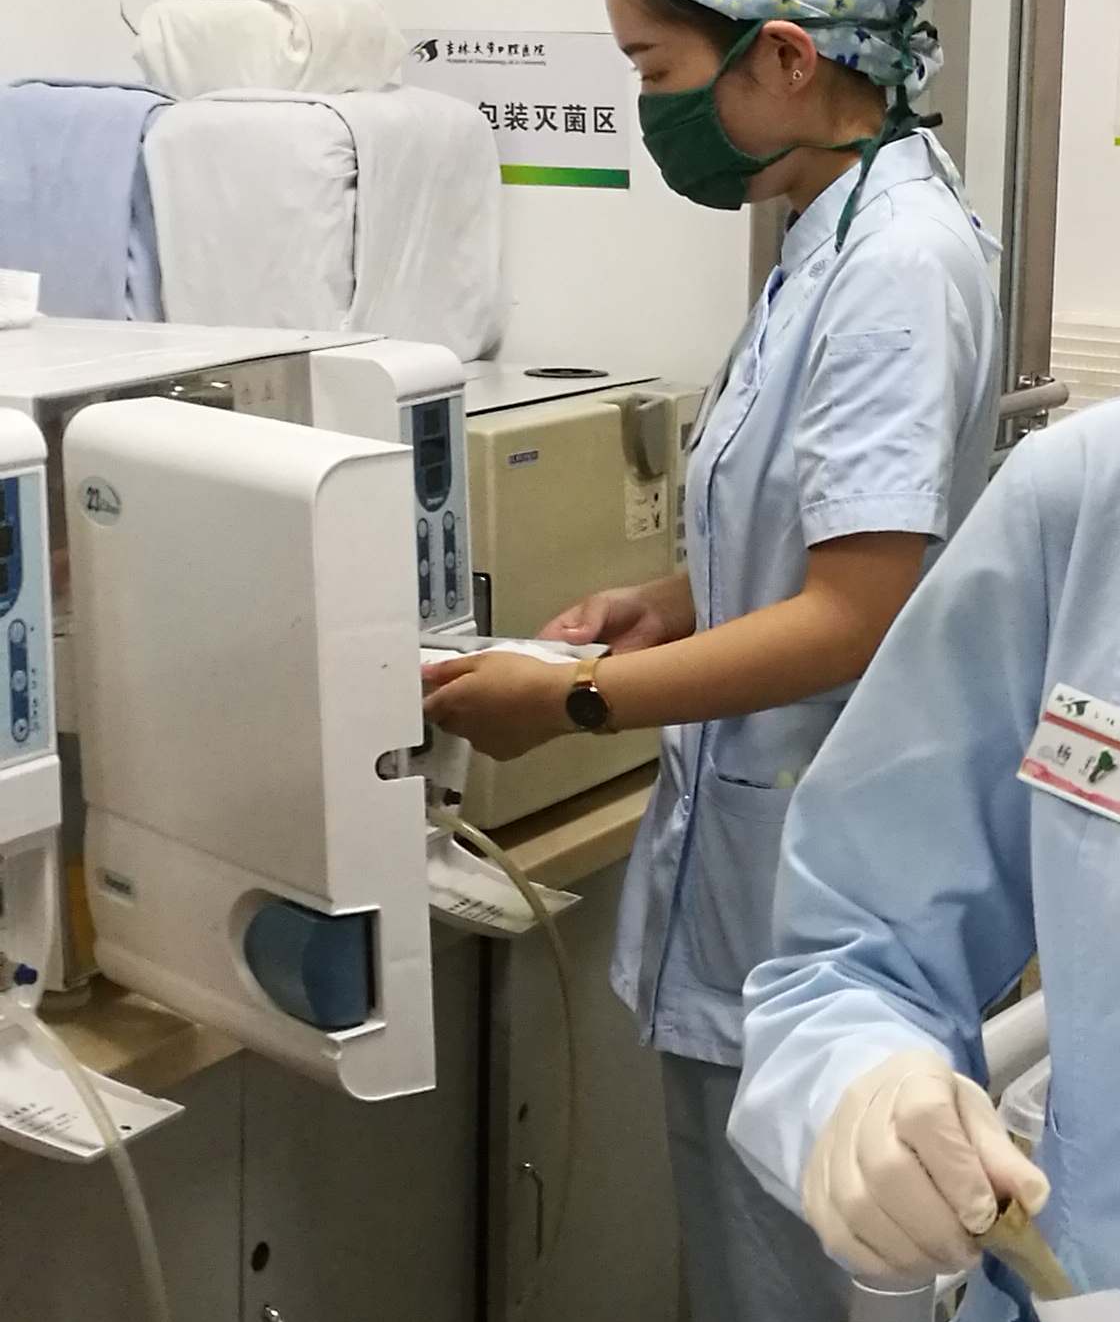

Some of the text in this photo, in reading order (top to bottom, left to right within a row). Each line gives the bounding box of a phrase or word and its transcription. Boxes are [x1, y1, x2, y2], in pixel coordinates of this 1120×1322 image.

[478, 101, 617, 134] 包装灭菌区
